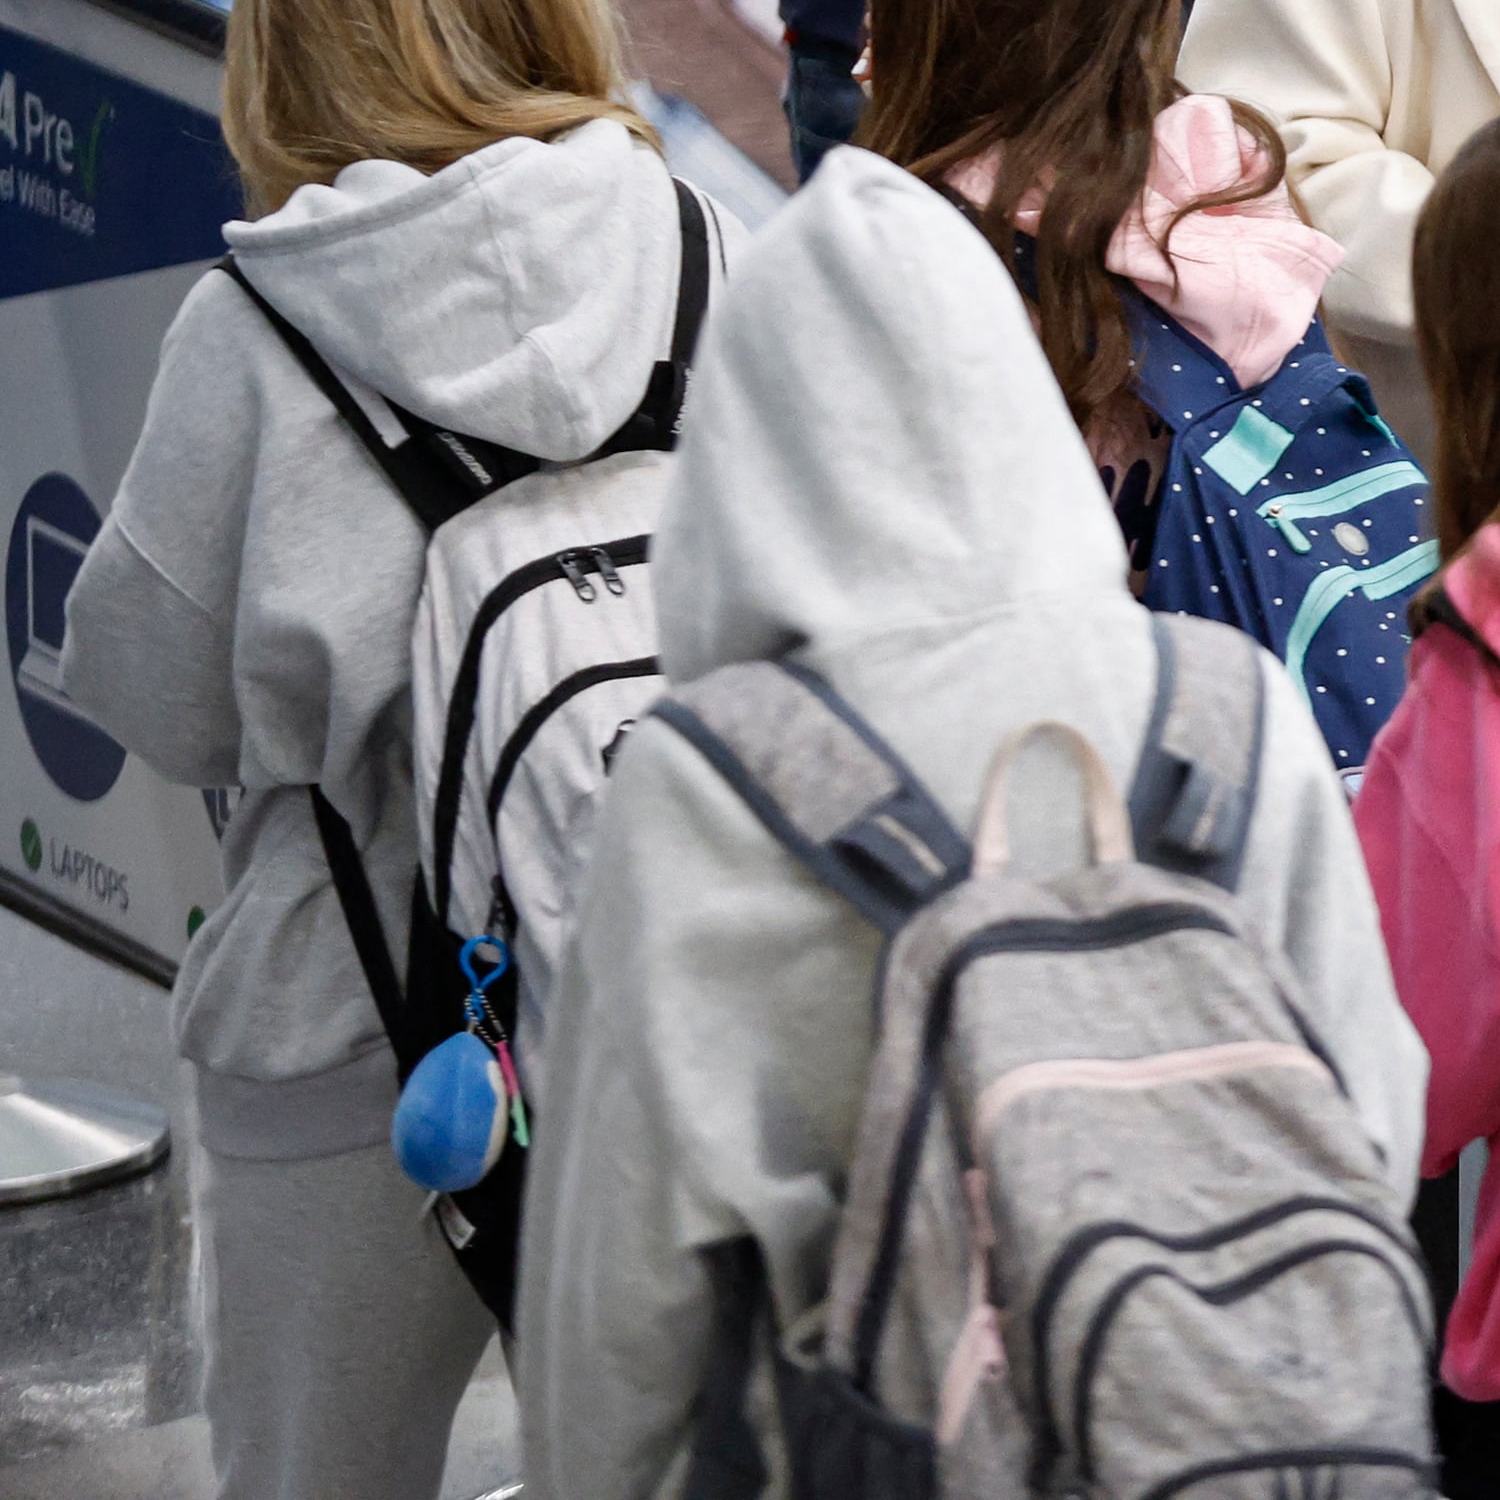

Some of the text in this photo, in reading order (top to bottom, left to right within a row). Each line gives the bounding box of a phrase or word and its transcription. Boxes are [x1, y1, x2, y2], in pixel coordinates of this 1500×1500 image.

[24, 90, 74, 174] Pre
[18, 169, 57, 217] With
[59, 188, 96, 236] Ease
[50, 836, 130, 912] LAPTOPS
